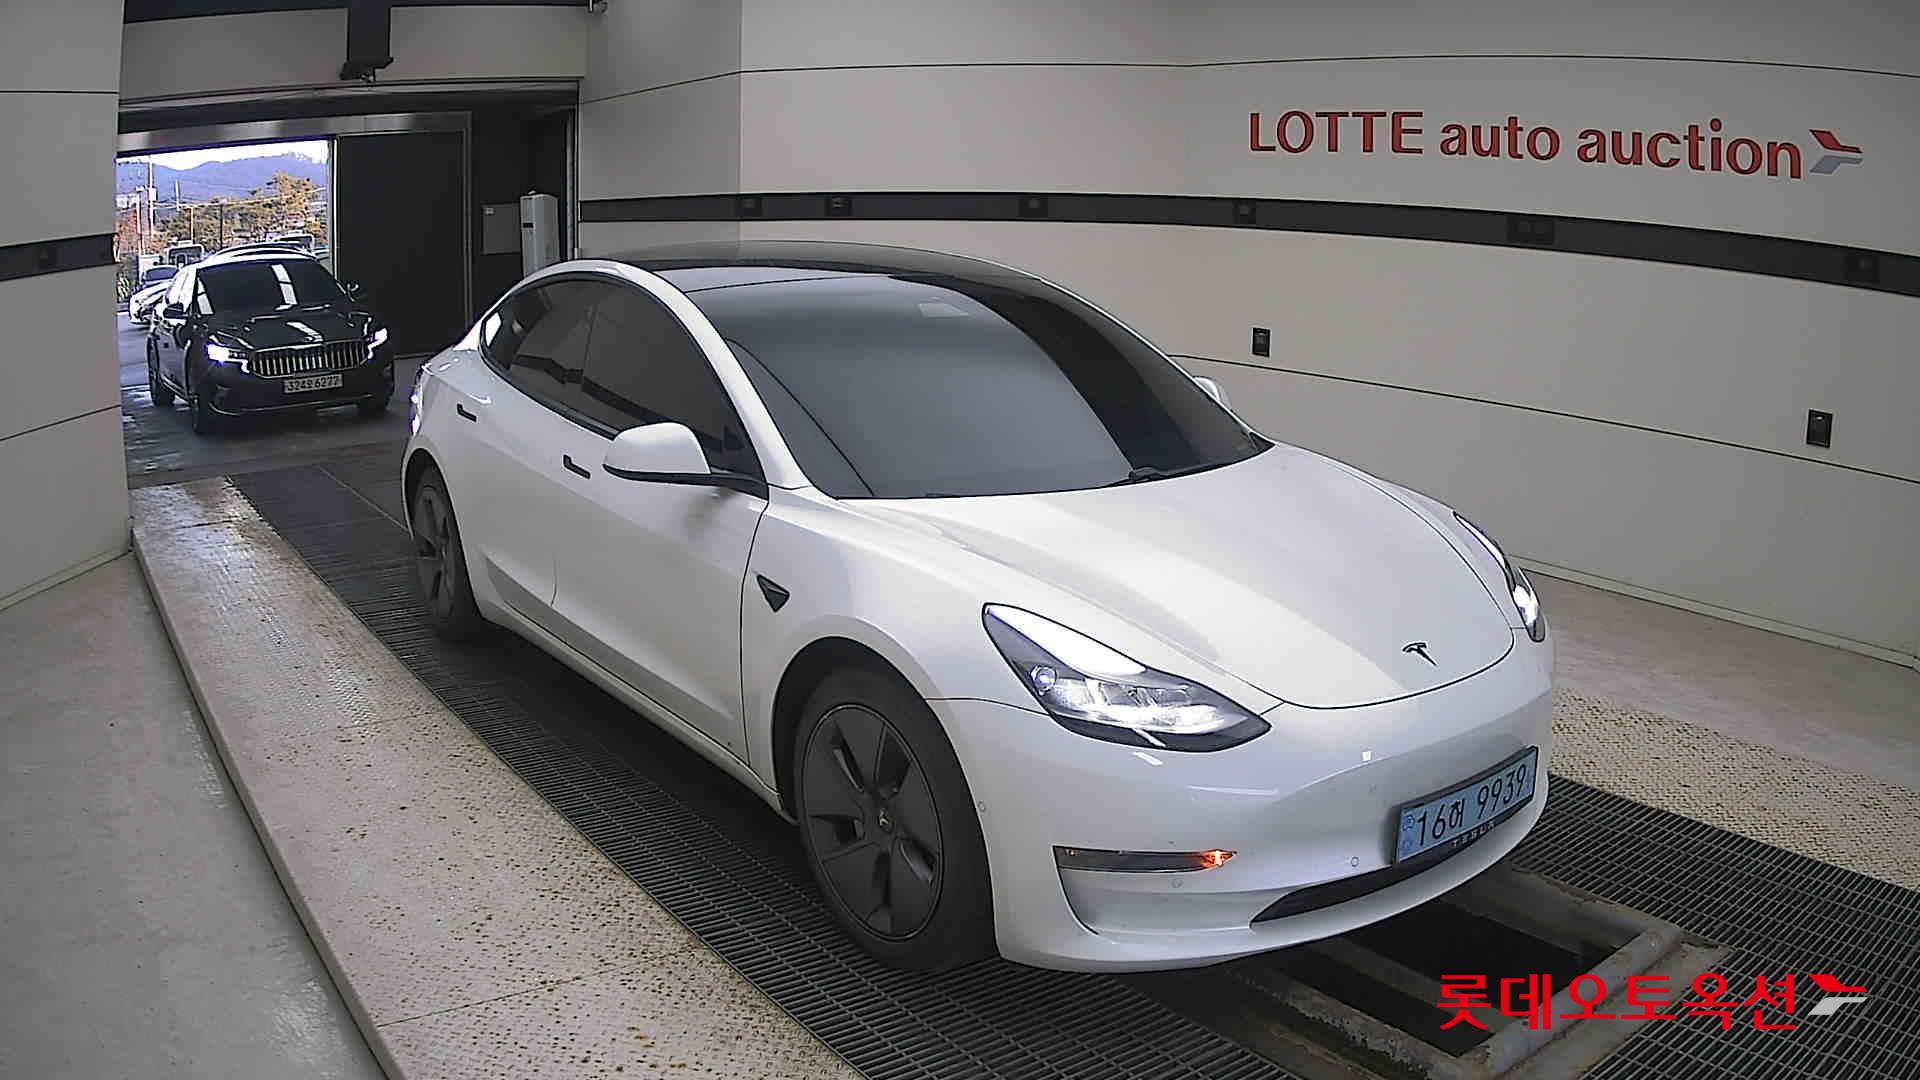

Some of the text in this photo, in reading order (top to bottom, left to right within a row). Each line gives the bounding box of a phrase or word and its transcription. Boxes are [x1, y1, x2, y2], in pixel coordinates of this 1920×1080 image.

[1249, 111, 1802, 178] LOTTE auto auction
[1417, 799, 1465, 846] 16허
[1477, 763, 1526, 820] 9939
